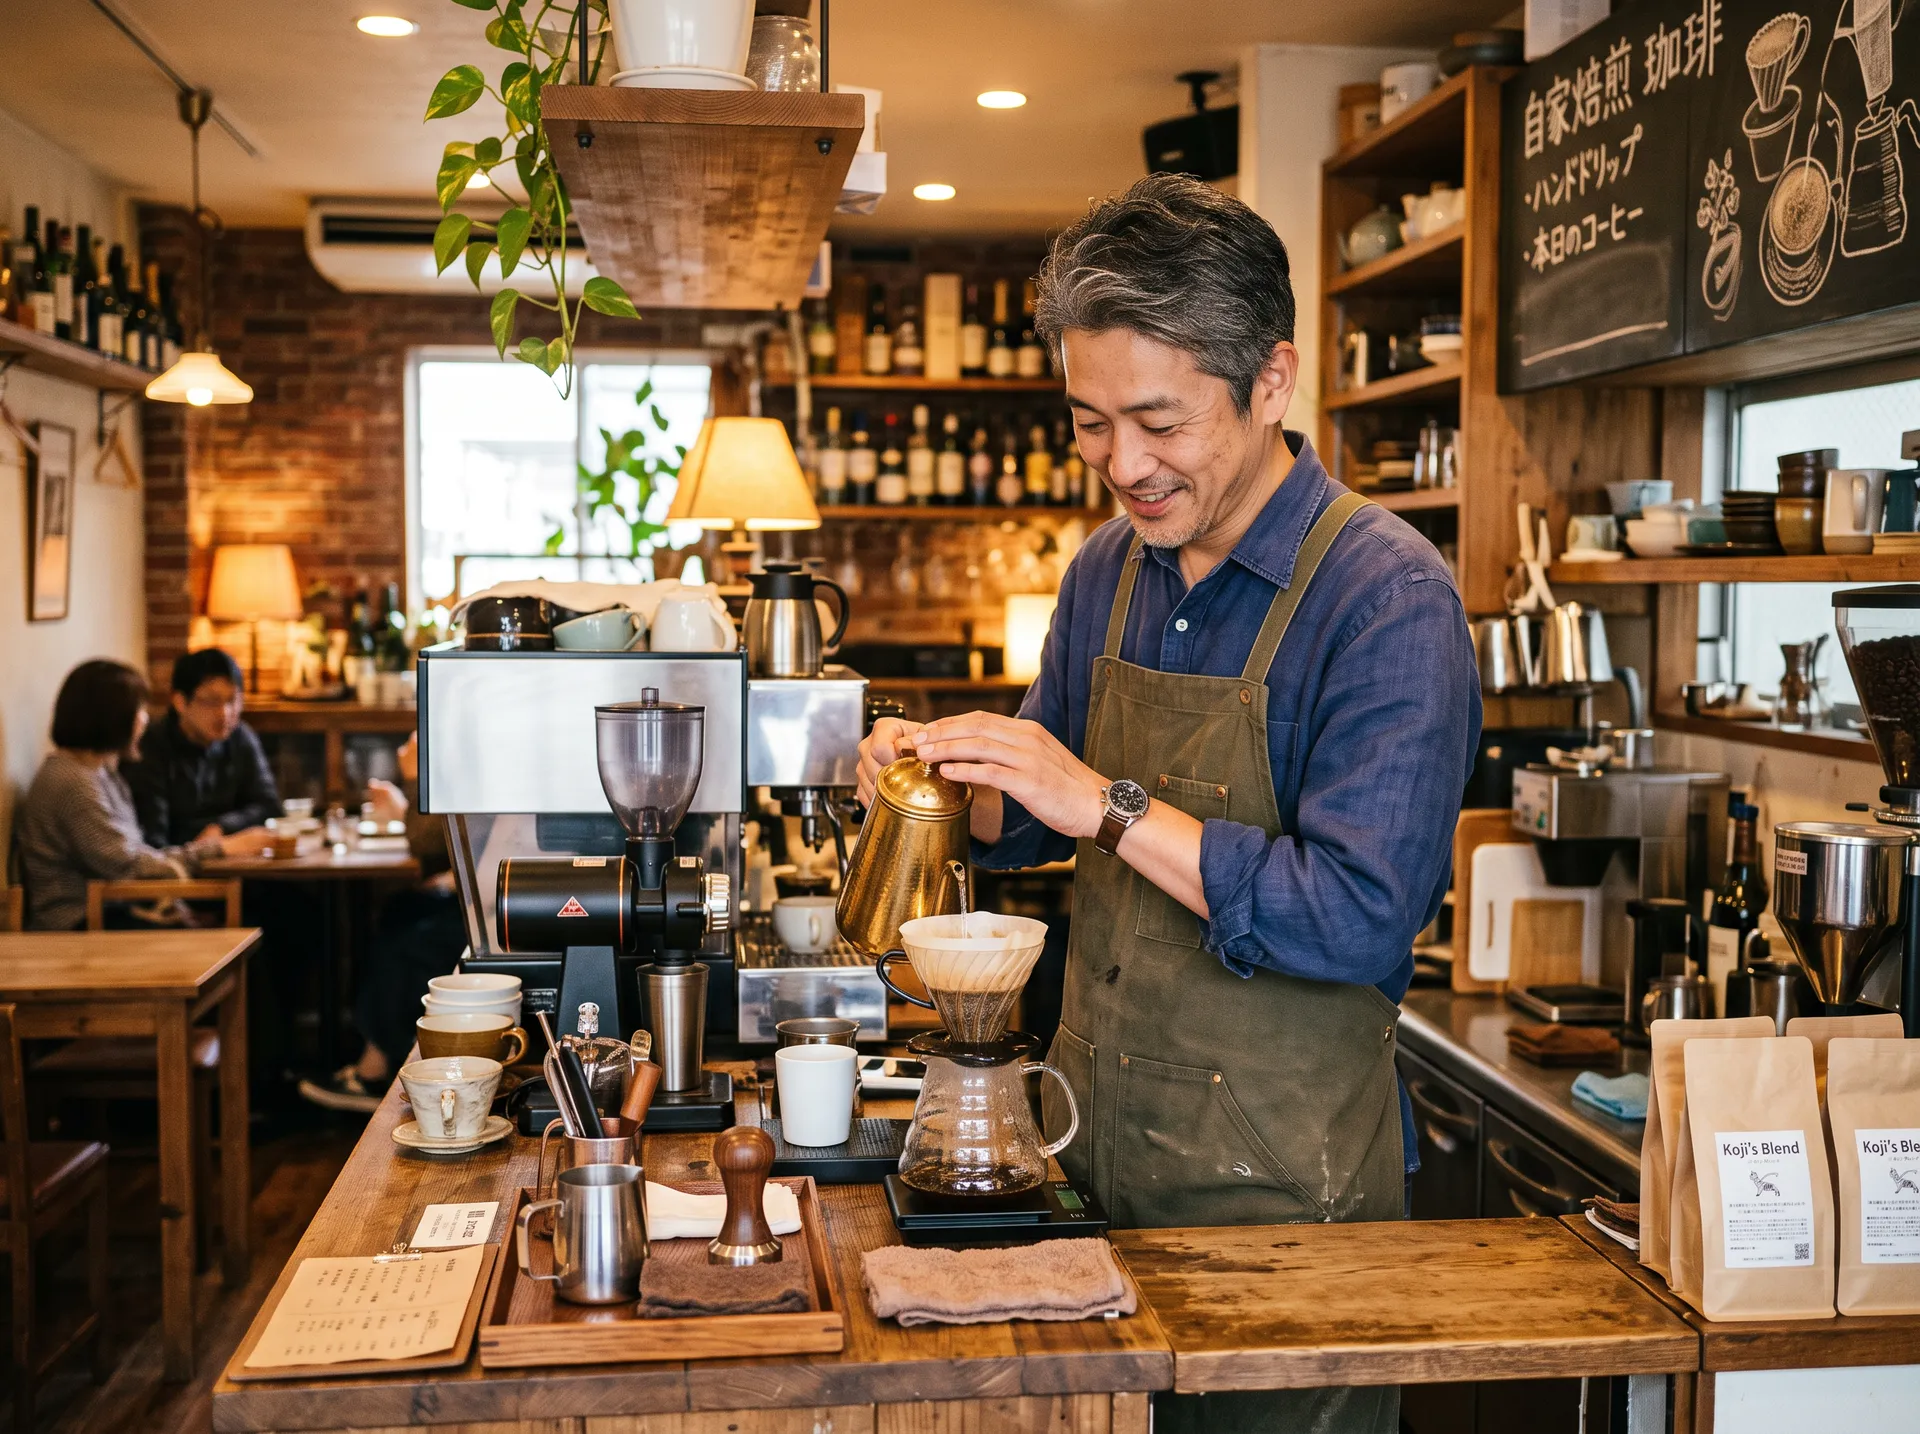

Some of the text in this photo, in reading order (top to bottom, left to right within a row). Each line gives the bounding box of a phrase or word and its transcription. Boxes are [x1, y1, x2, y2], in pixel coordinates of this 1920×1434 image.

[1525, 0, 1724, 160] 自家焙煎 珈琲
[1723, 1141, 1800, 1158] Koji's Blend
[1863, 1139, 1898, 1156] Koji's
